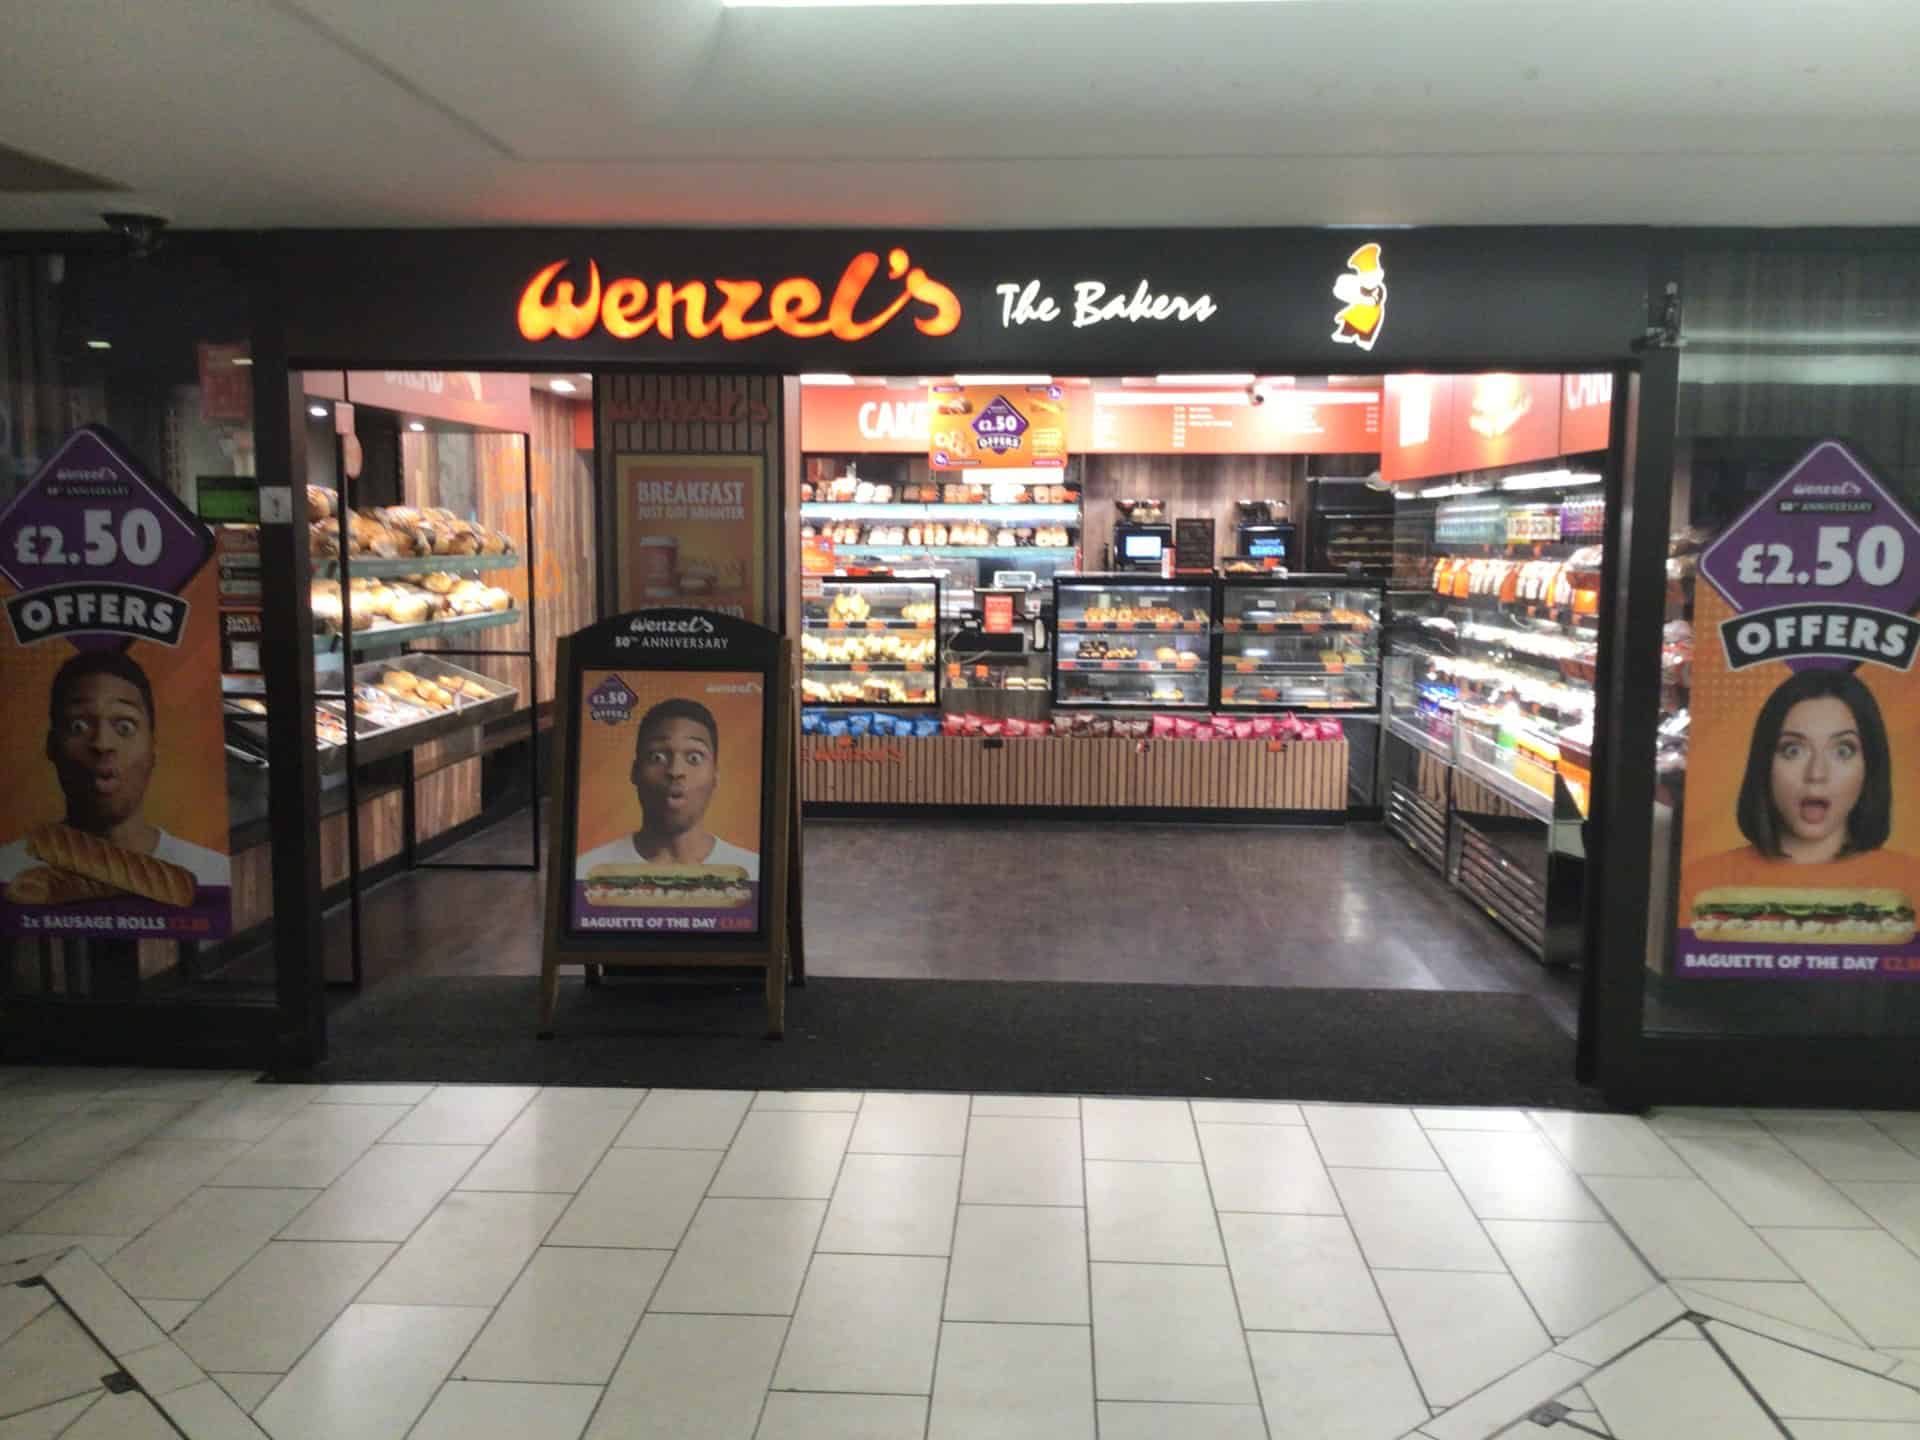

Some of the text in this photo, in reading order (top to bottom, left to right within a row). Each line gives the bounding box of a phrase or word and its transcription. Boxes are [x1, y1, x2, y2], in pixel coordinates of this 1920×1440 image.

[516, 247, 1217, 342] Wenzel's The Bakers
[637, 480, 744, 505] BREAKFAST
[14, 508, 163, 566] £2.50
[1737, 525, 1905, 586] £2.50
[21, 594, 174, 633] OFFERS
[630, 616, 714, 632] Wenzel's
[641, 637, 729, 649] ANNIVERSARY
[1736, 614, 1909, 657] OFFERS
[43, 915, 113, 929] SAUSAGE
[117, 917, 166, 929] ROLLS
[580, 917, 644, 928] BAGUETTE
[667, 918, 690, 929] THE
[693, 918, 717, 929] DAY
[1684, 954, 1774, 969] BAGUETTE
[1777, 955, 1803, 970] OF
[1805, 956, 1840, 970] THE
[1843, 957, 1878, 971] DAY
